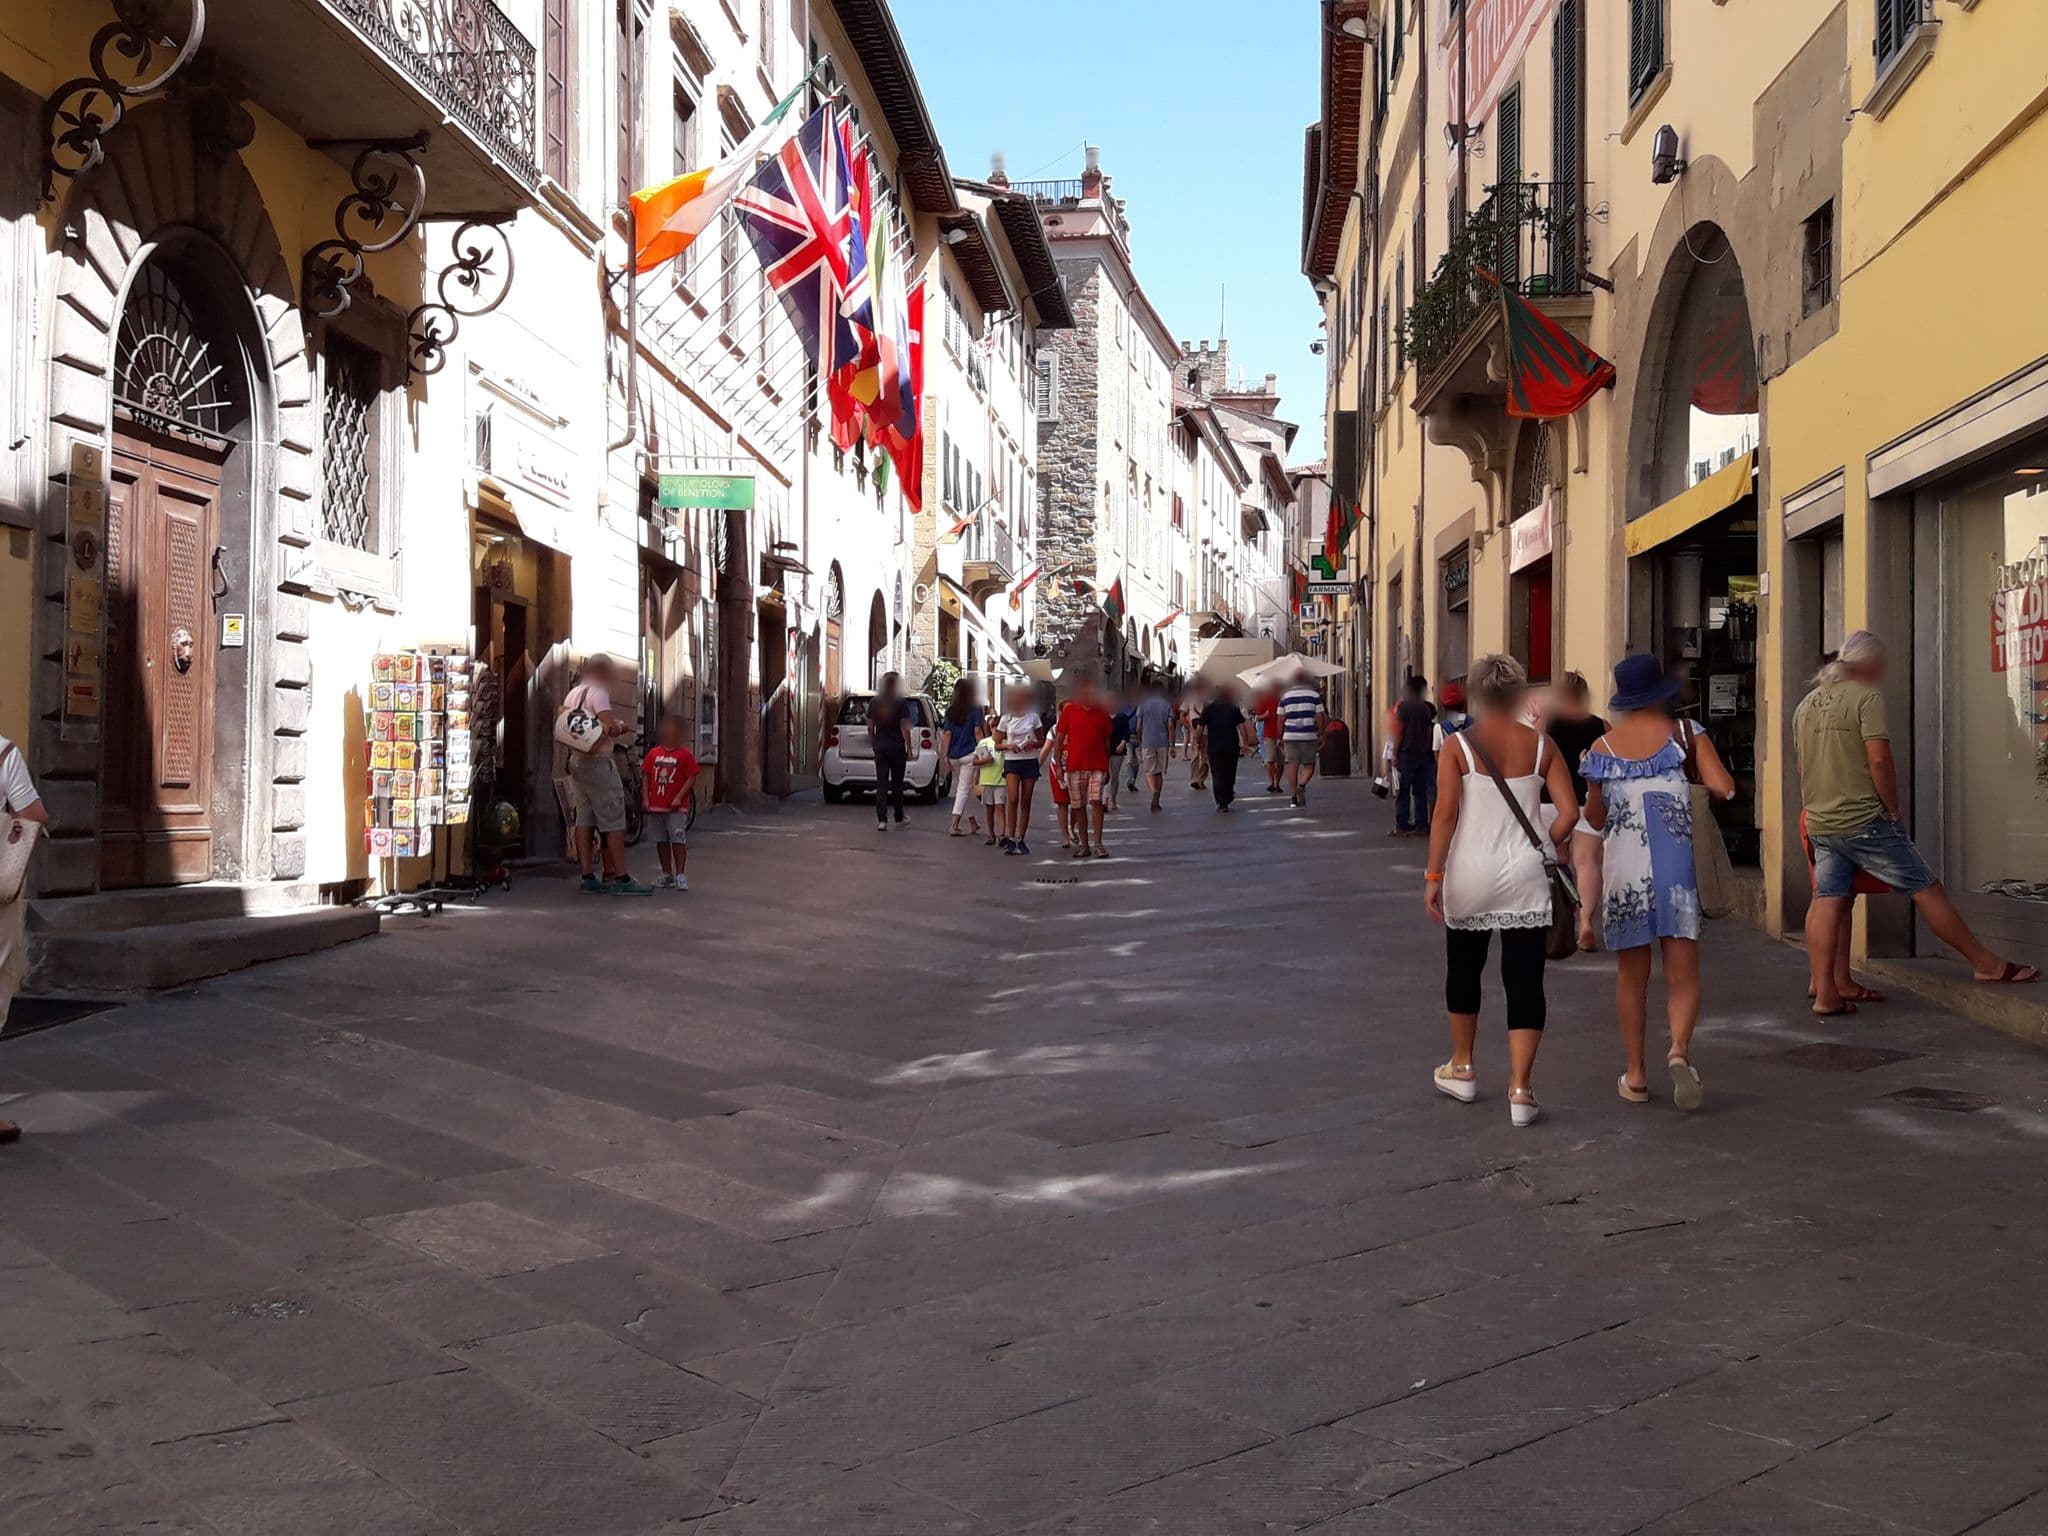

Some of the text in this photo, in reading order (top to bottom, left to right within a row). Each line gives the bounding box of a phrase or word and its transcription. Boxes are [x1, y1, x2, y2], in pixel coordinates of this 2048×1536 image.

[662, 480, 730, 489] UNDERCOLORS
[662, 488, 726, 497] OF BENETTON
[1303, 606, 1313, 617] T
[1994, 582, 2048, 634] SALDI
[1995, 625, 2044, 668] TUTTO
